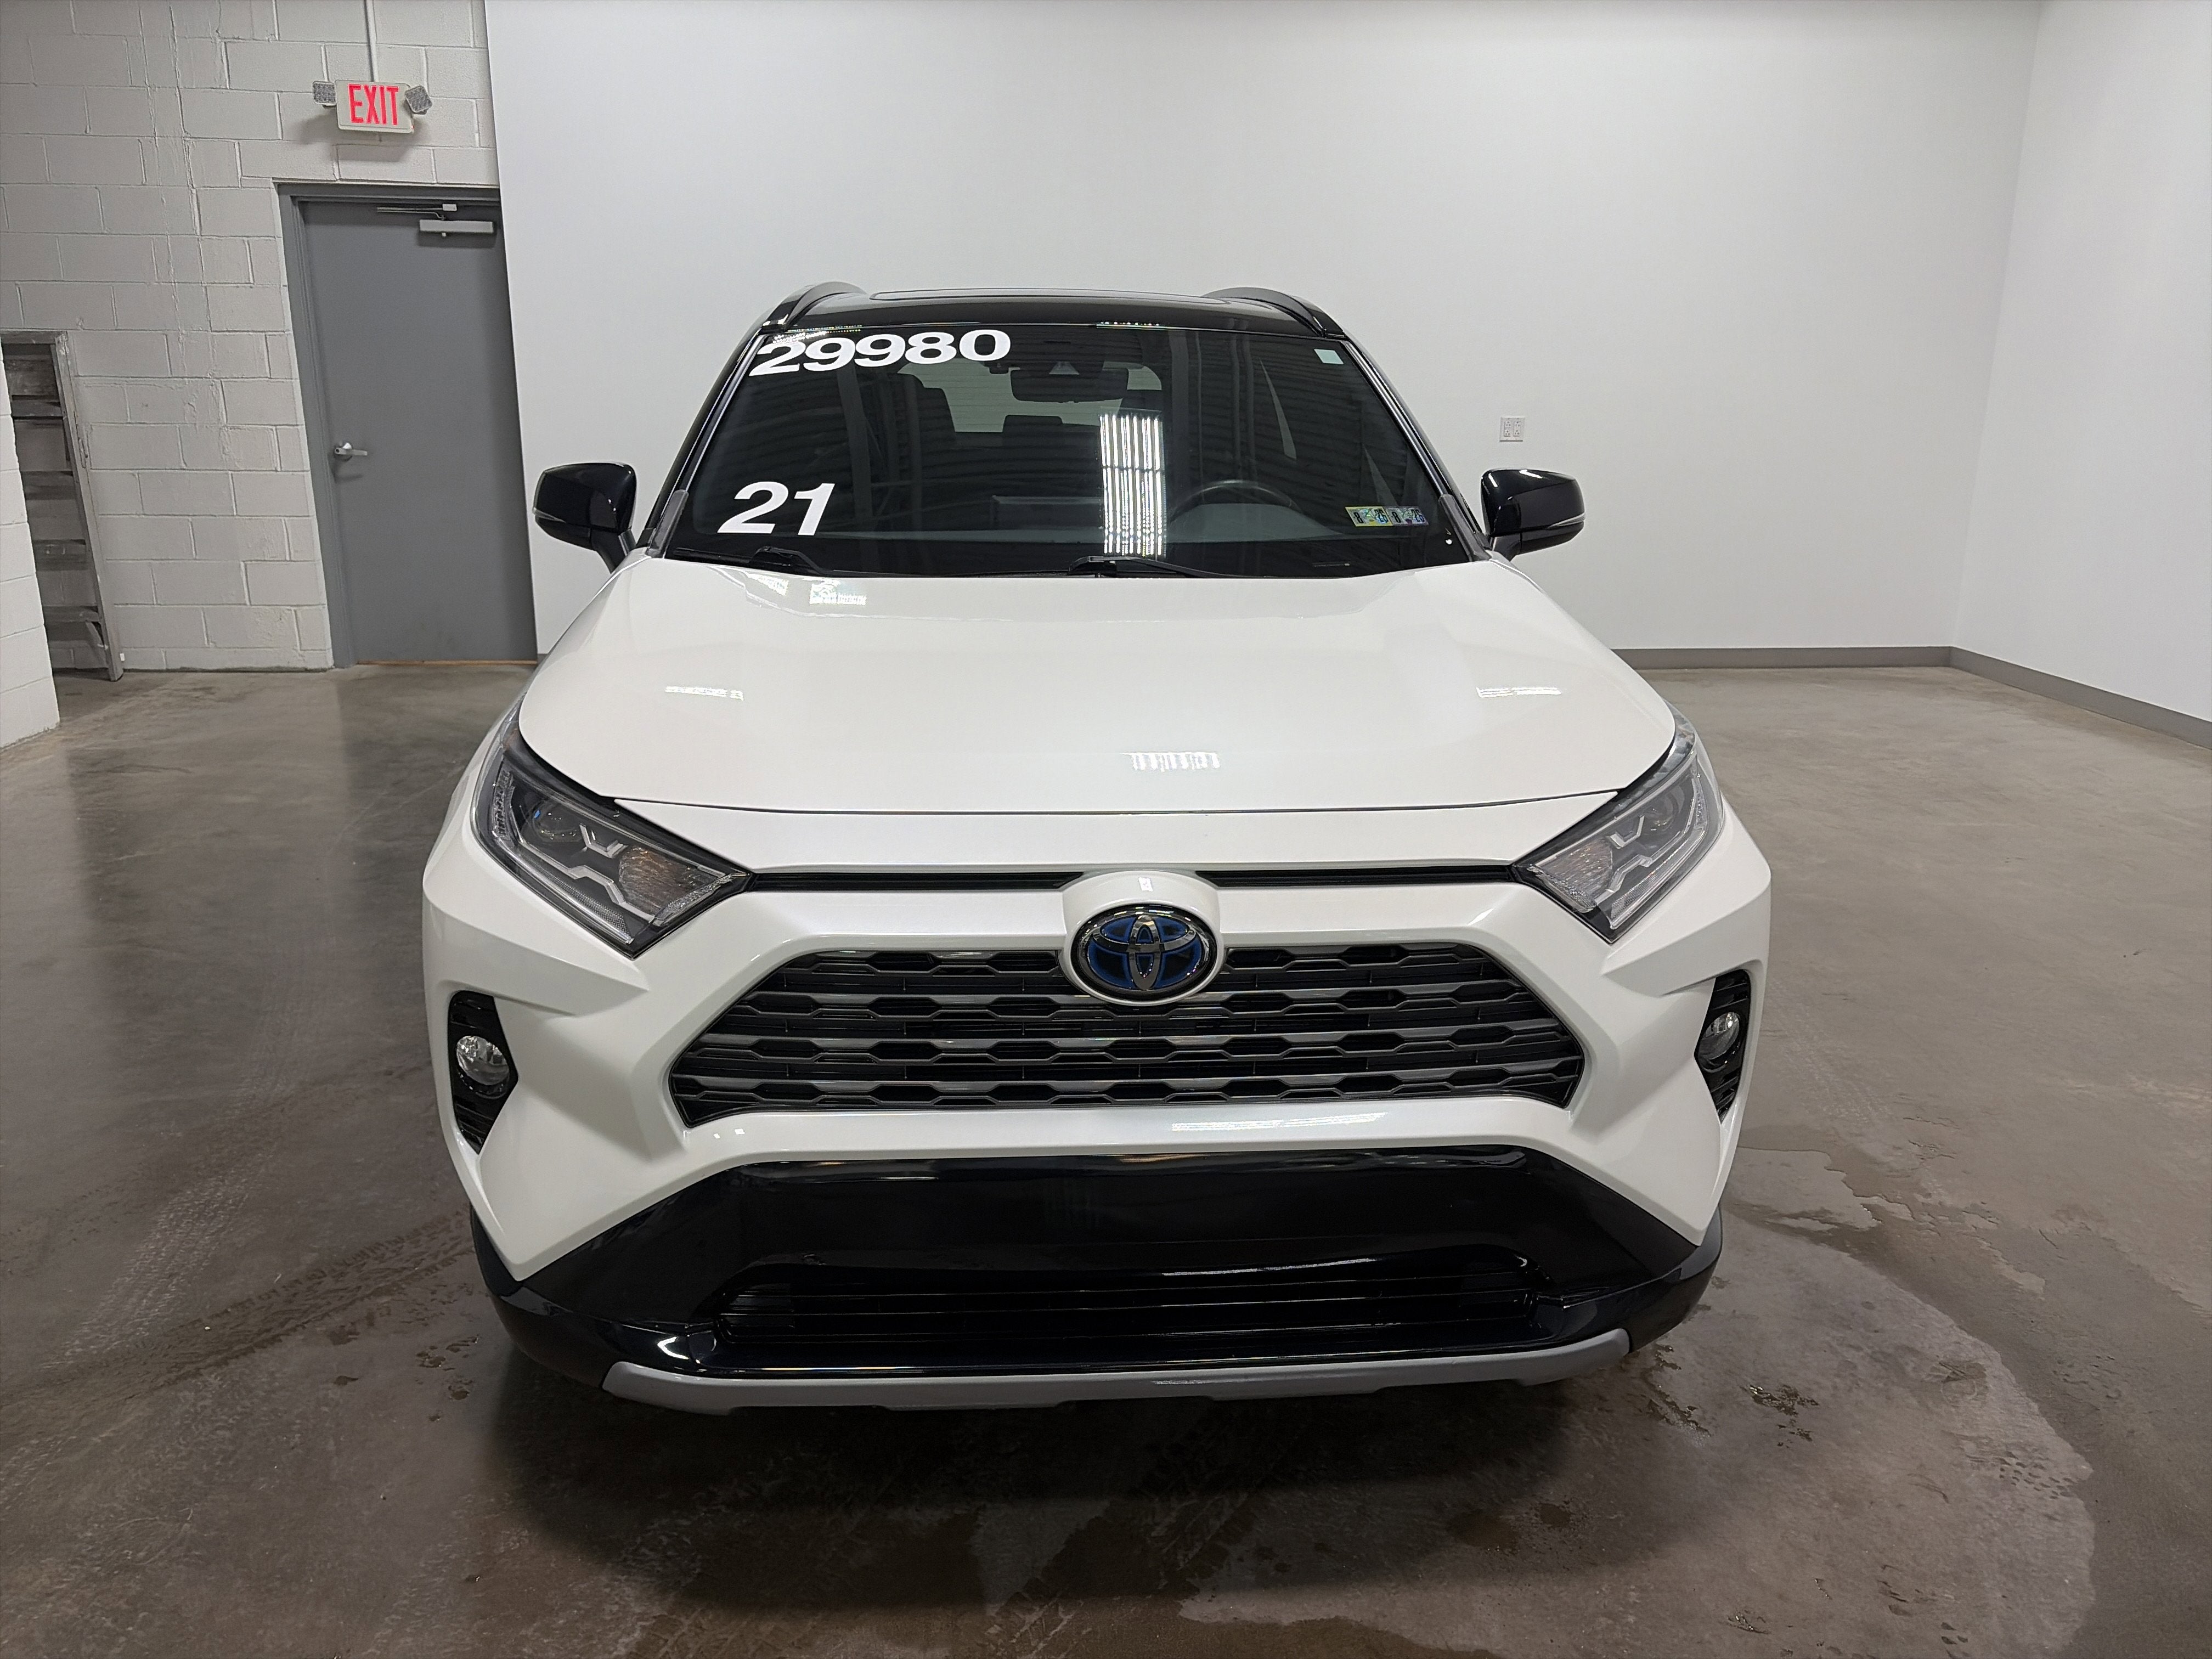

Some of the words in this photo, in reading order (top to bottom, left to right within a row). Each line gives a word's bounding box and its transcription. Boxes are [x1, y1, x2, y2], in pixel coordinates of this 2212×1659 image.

[348, 83, 399, 125] EXIT
[749, 329, 1012, 376] 29980
[717, 481, 835, 536] 21
[1353, 512, 1364, 523] 8
[1375, 509, 1389, 522] 26
[1392, 511, 1402, 523] 8
